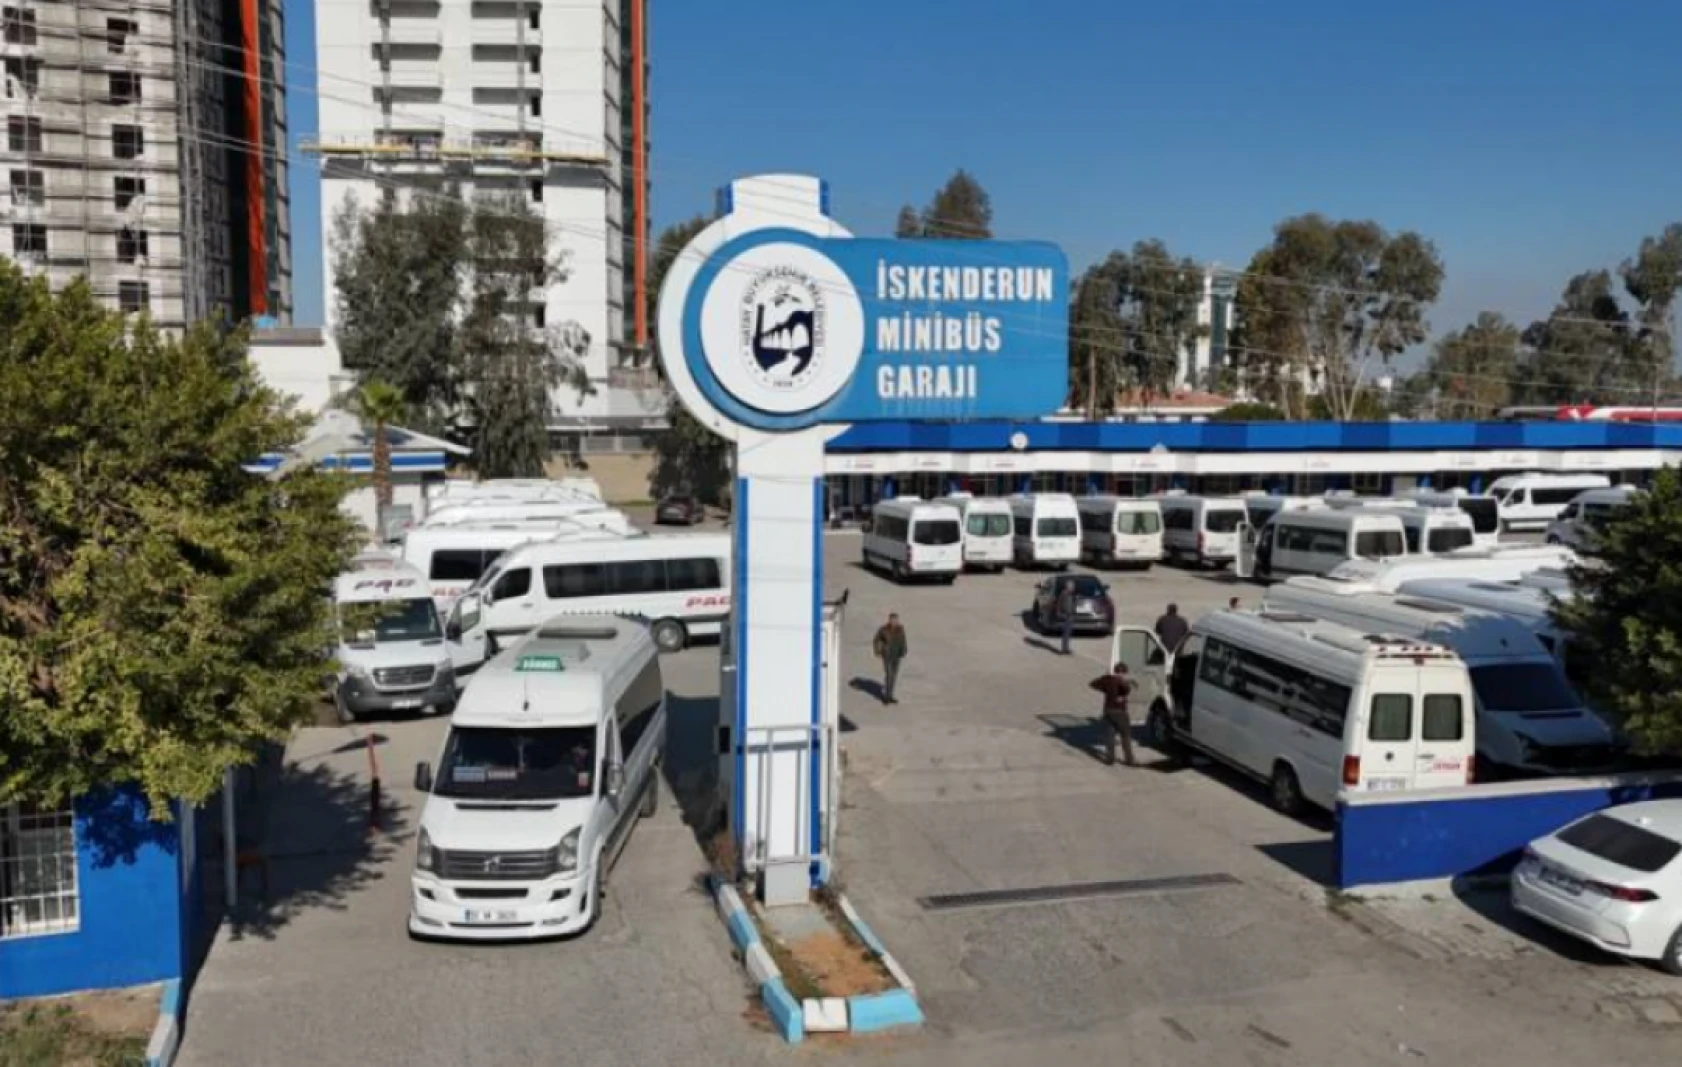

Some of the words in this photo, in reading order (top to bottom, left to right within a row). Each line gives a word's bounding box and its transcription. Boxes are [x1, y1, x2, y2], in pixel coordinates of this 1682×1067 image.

[877, 258, 1053, 301] İSKENDERUN
[877, 311, 1001, 351] MİNİBÜS
[877, 364, 977, 399] GARAJI
